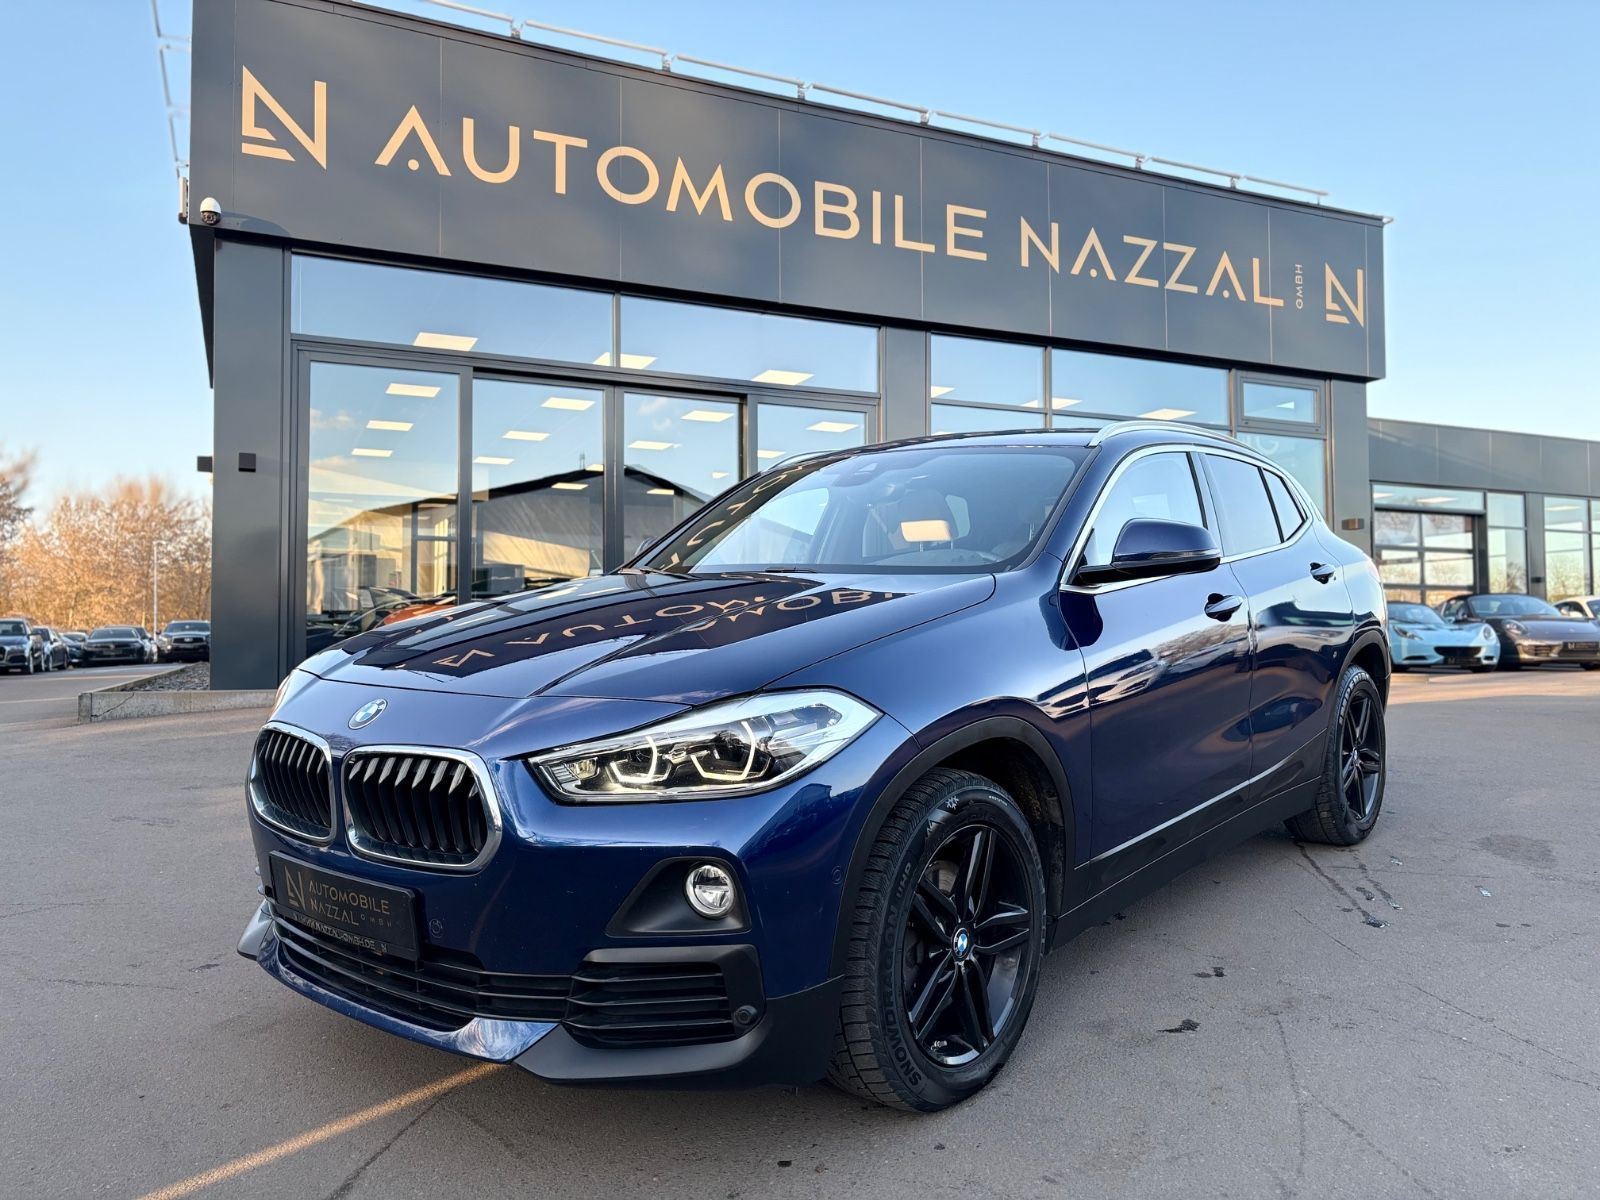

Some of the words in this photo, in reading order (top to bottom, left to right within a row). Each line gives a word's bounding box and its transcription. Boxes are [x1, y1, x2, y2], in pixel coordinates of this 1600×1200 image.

[375, 104, 988, 261] AUTOMOBILE
[1020, 215, 1284, 307] NAZZAL
[1295, 263, 1304, 310] GMBH
[309, 881, 390, 914] AUTOMOBILE
[309, 899, 359, 926] NAZZAL
